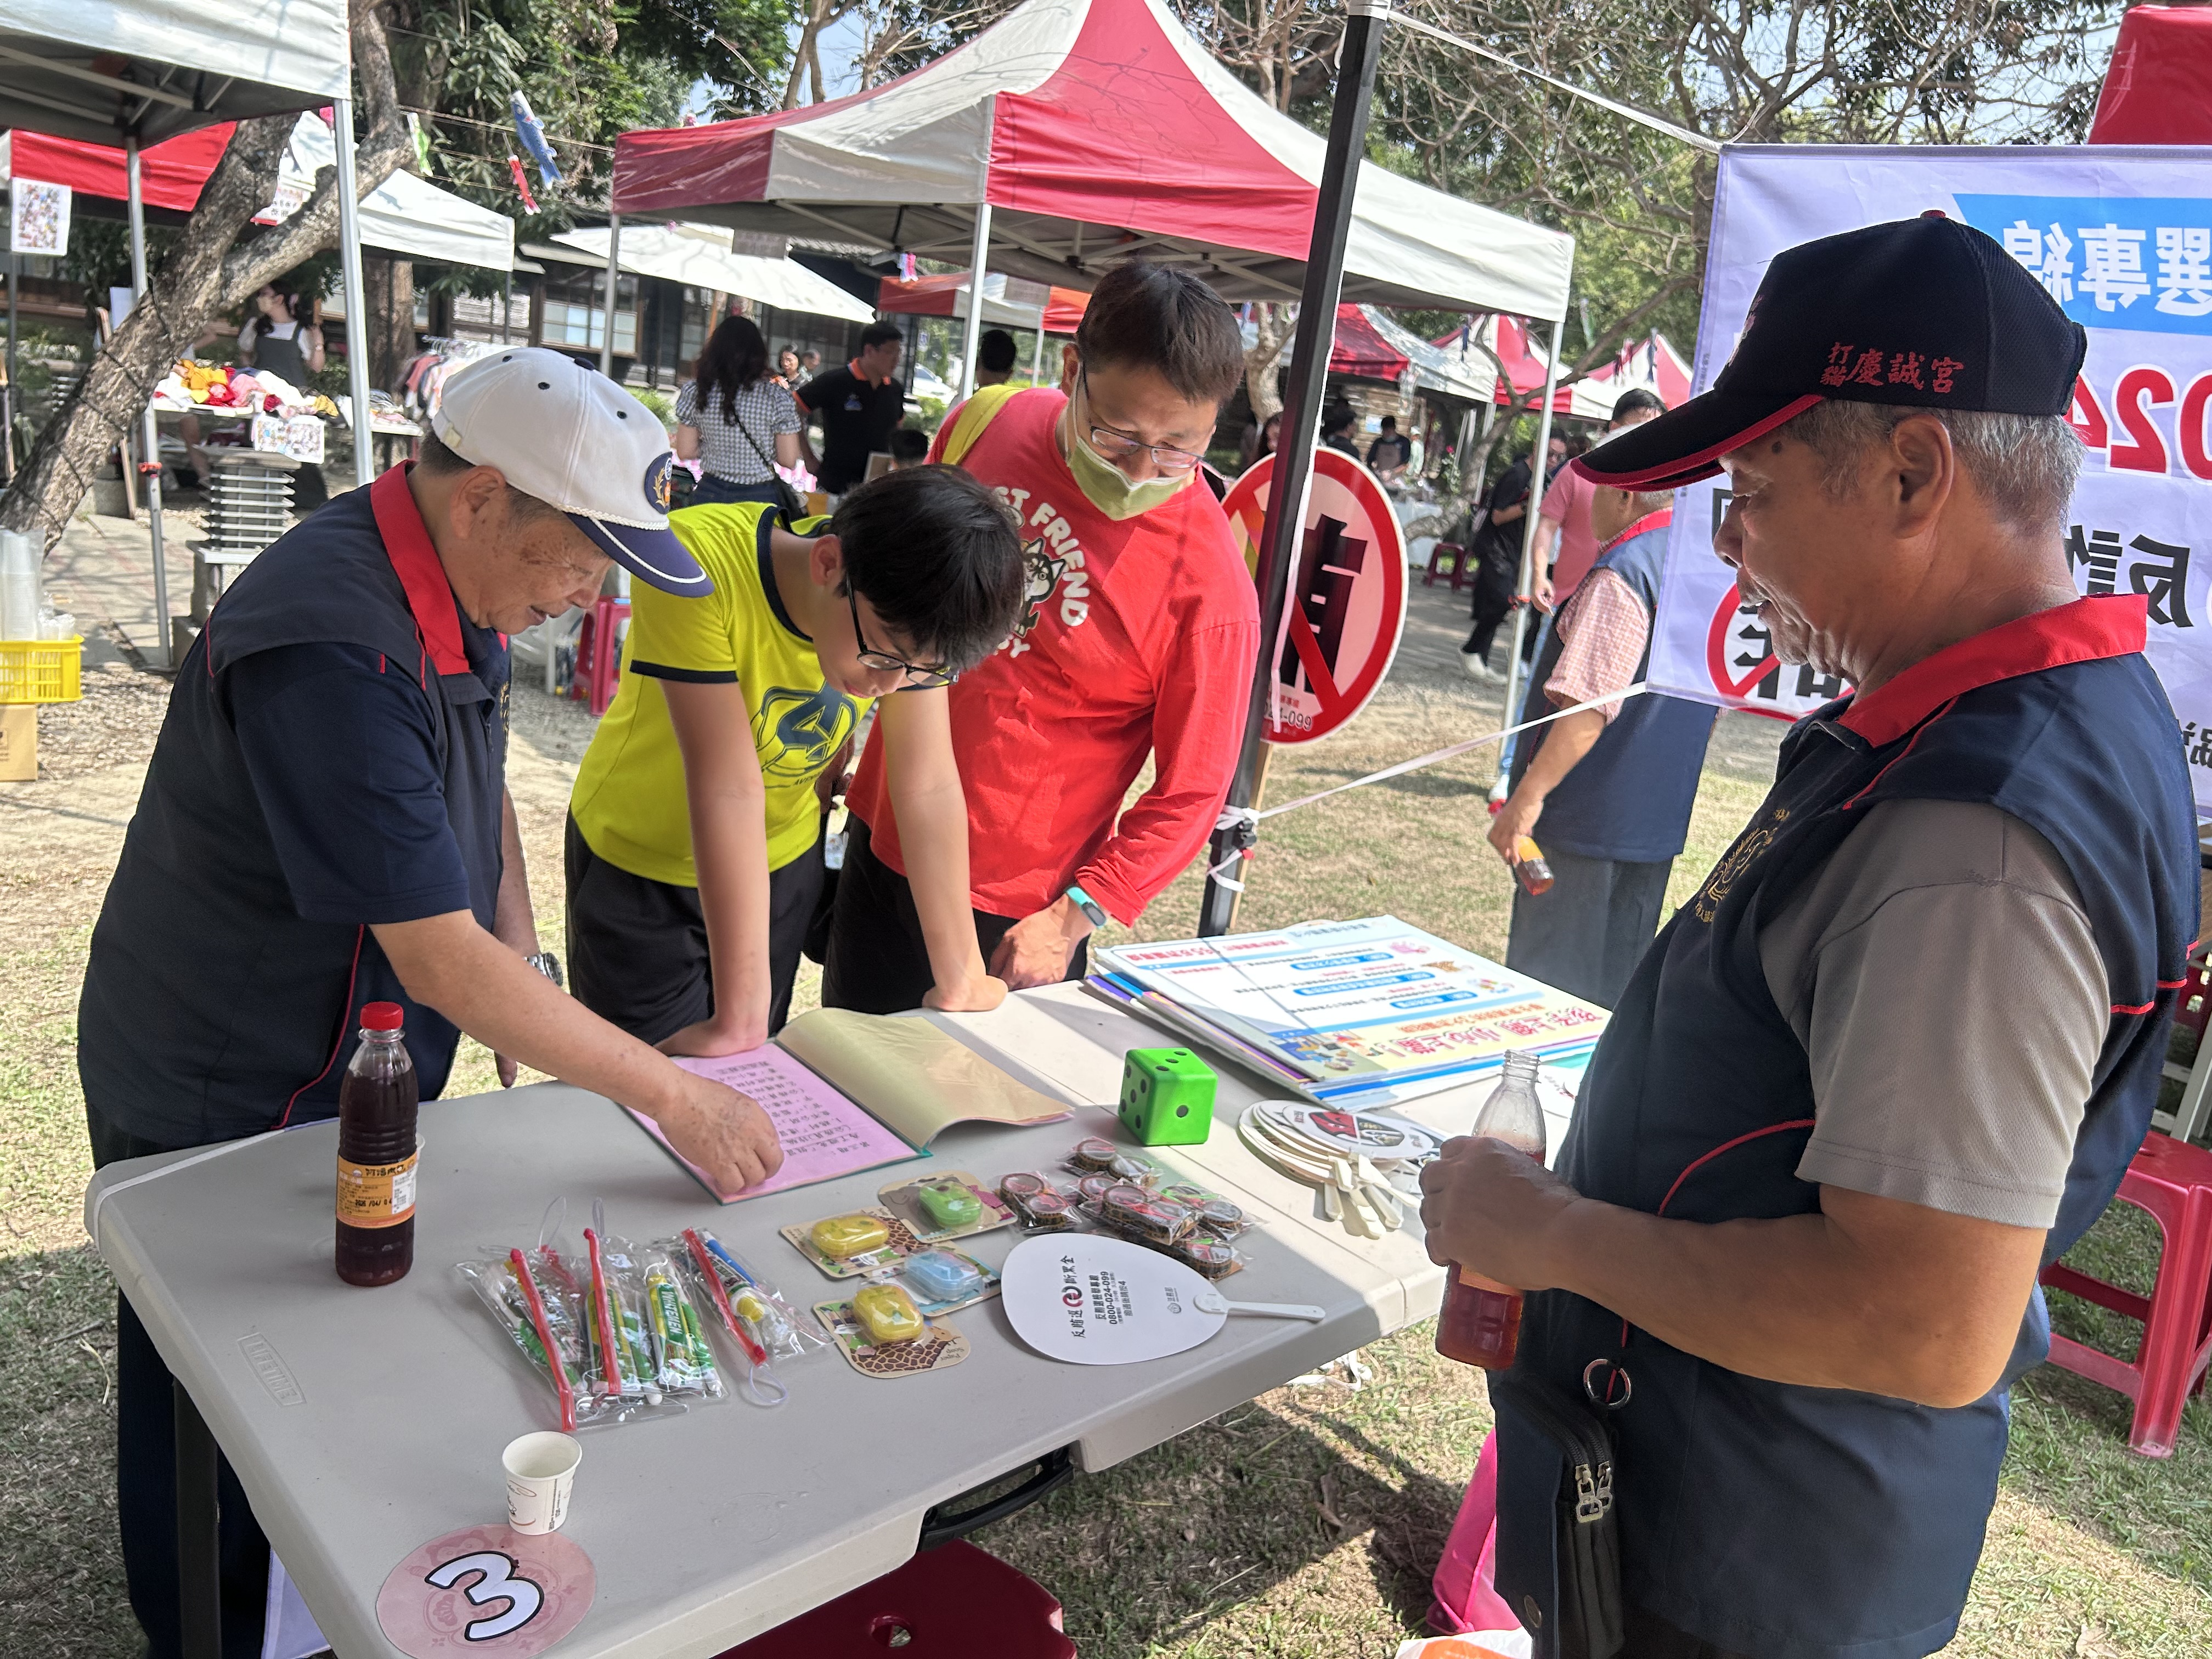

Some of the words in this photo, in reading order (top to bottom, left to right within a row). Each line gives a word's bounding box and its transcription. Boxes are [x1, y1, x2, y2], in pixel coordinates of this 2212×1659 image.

[1030, 502, 1091, 627] FRIEND
[1101, 1271, 1118, 1324] 0800-024-099
[424, 1550, 545, 1642] 3
